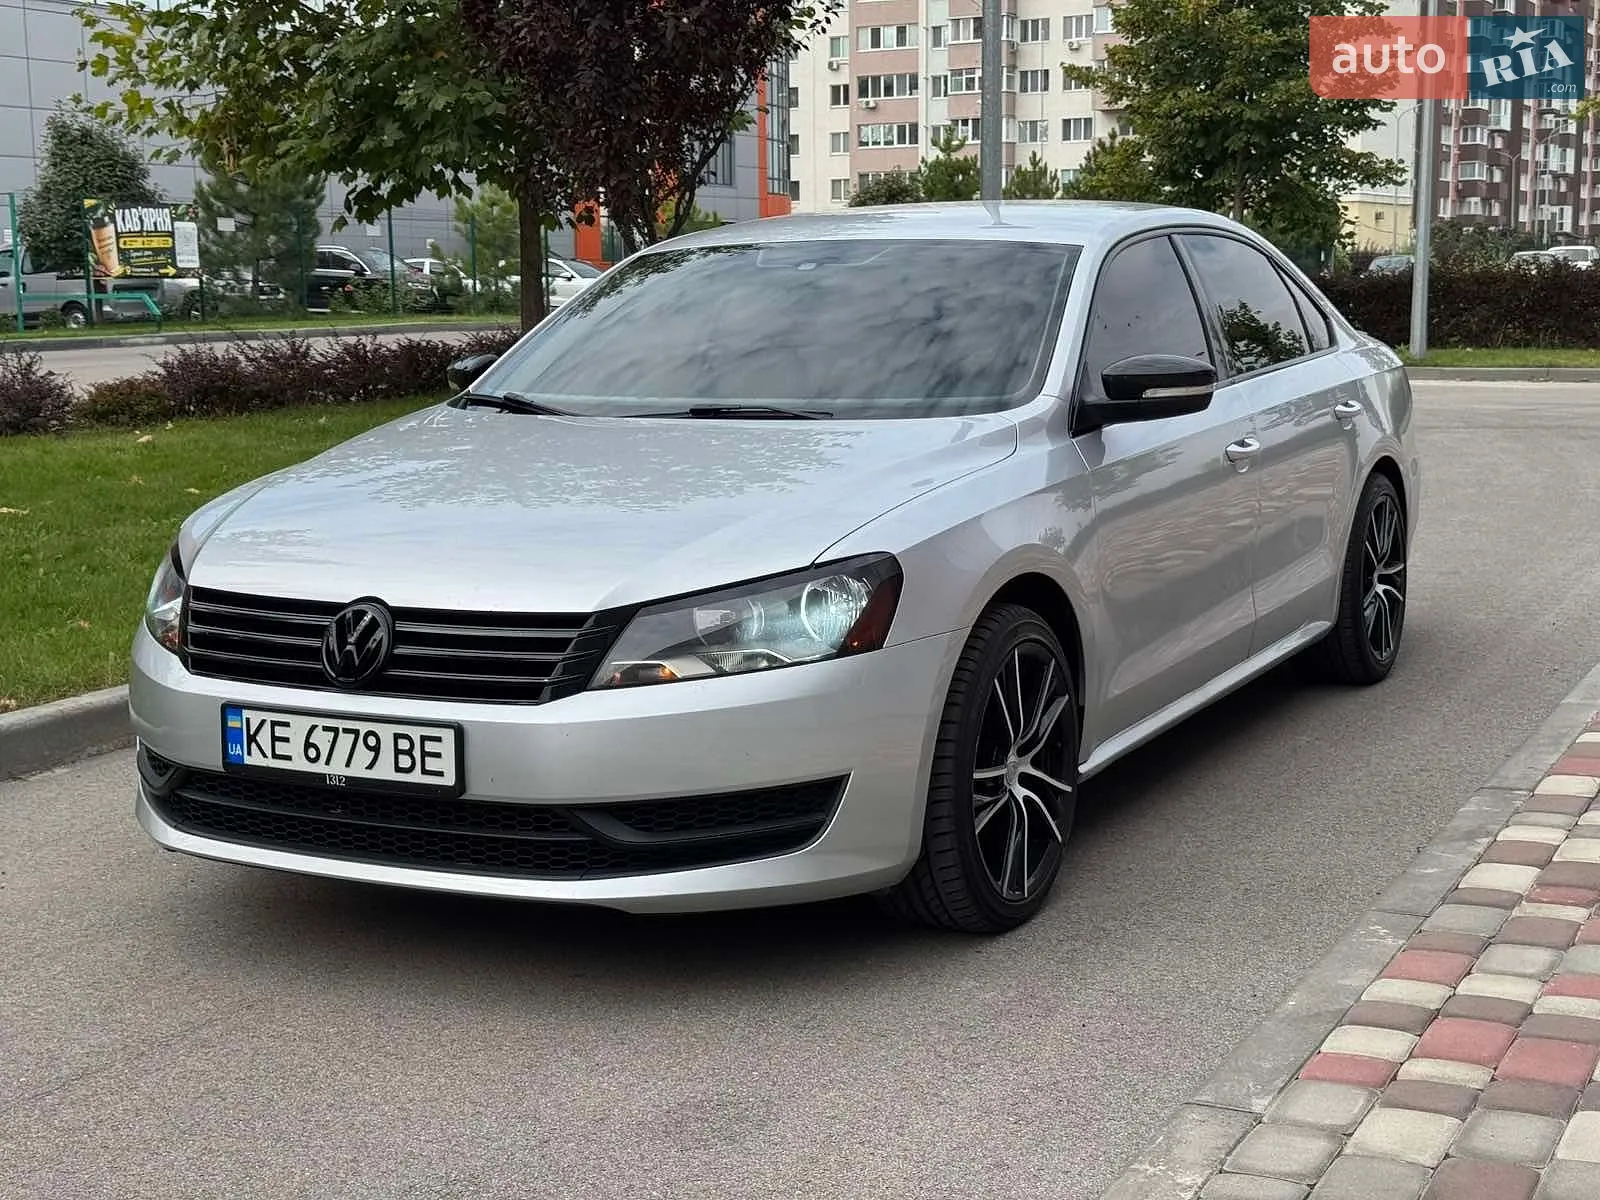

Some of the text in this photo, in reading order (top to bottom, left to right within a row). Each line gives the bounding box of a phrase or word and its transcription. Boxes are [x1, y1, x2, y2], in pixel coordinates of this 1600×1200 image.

[115, 207, 172, 232] КАВ'ЯРНЯ
[228, 743, 243, 756] UA
[245, 717, 445, 777] KE 6779 BE
